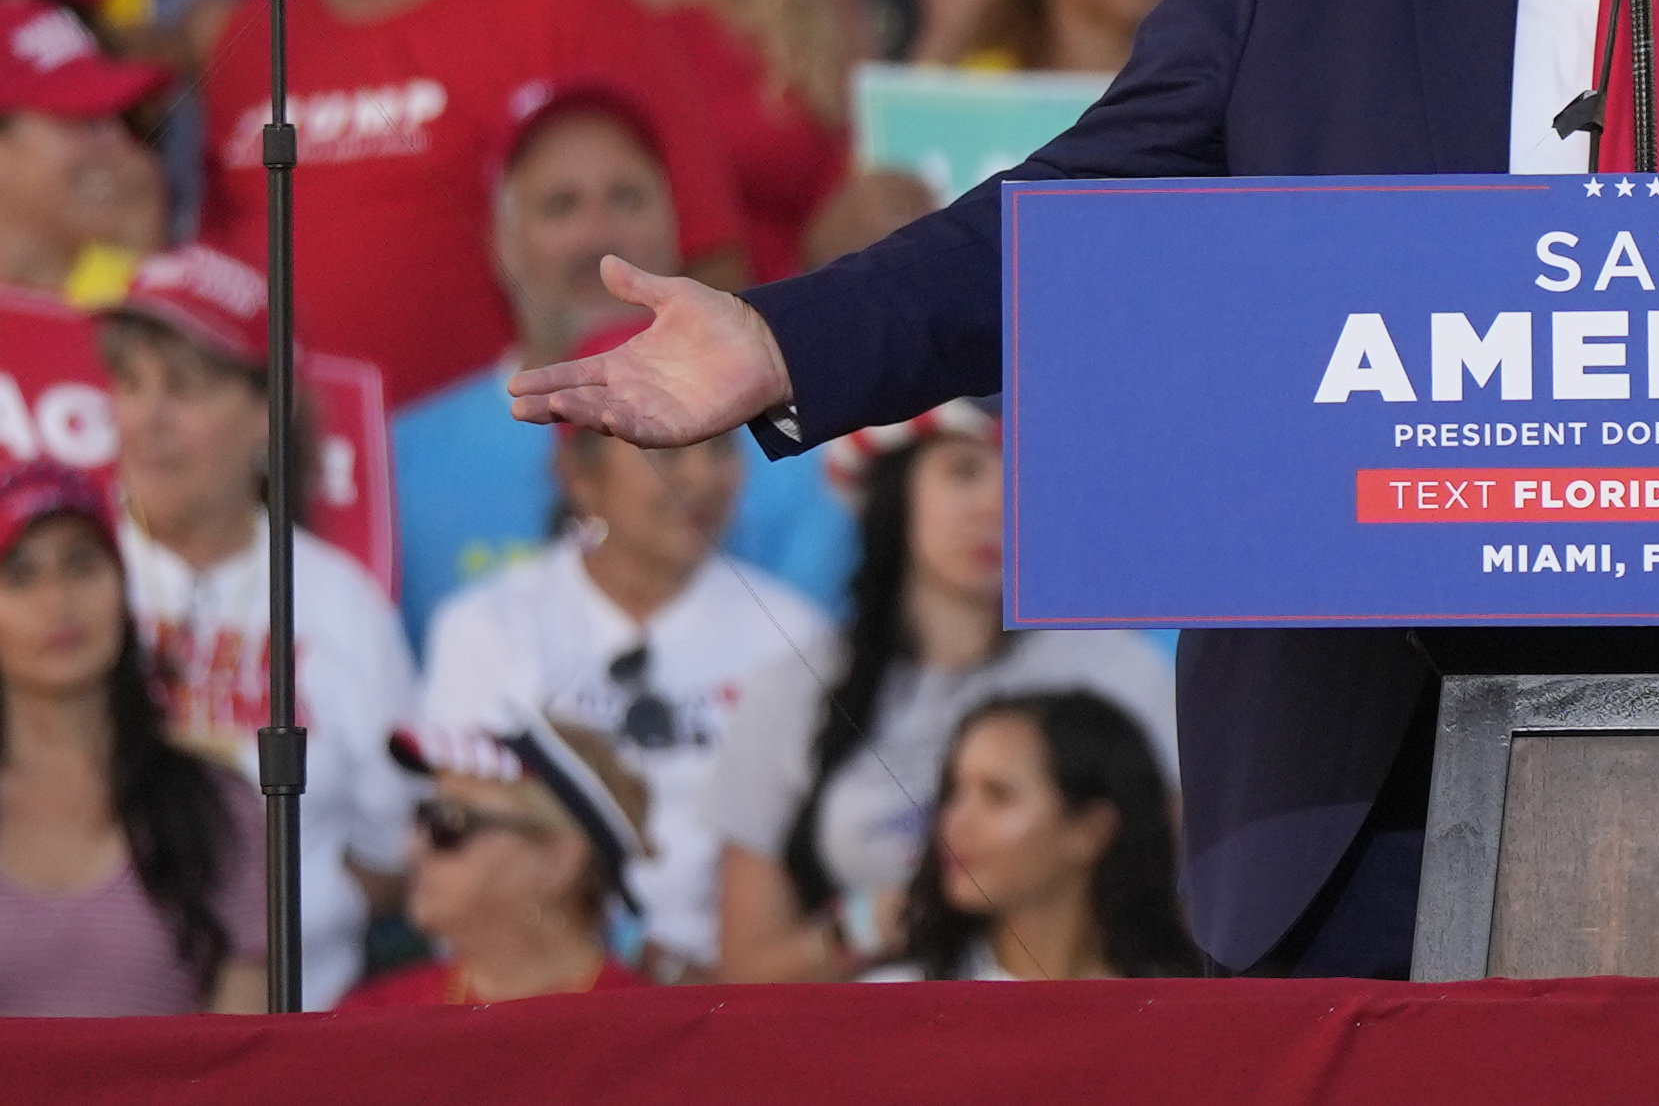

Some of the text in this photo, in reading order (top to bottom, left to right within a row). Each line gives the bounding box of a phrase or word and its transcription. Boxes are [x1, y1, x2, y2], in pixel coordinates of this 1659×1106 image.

[1394, 422, 1588, 448] PRESIDENT
[1389, 481, 1496, 510] TEXT
[1482, 543, 1627, 578] MIAMI,
